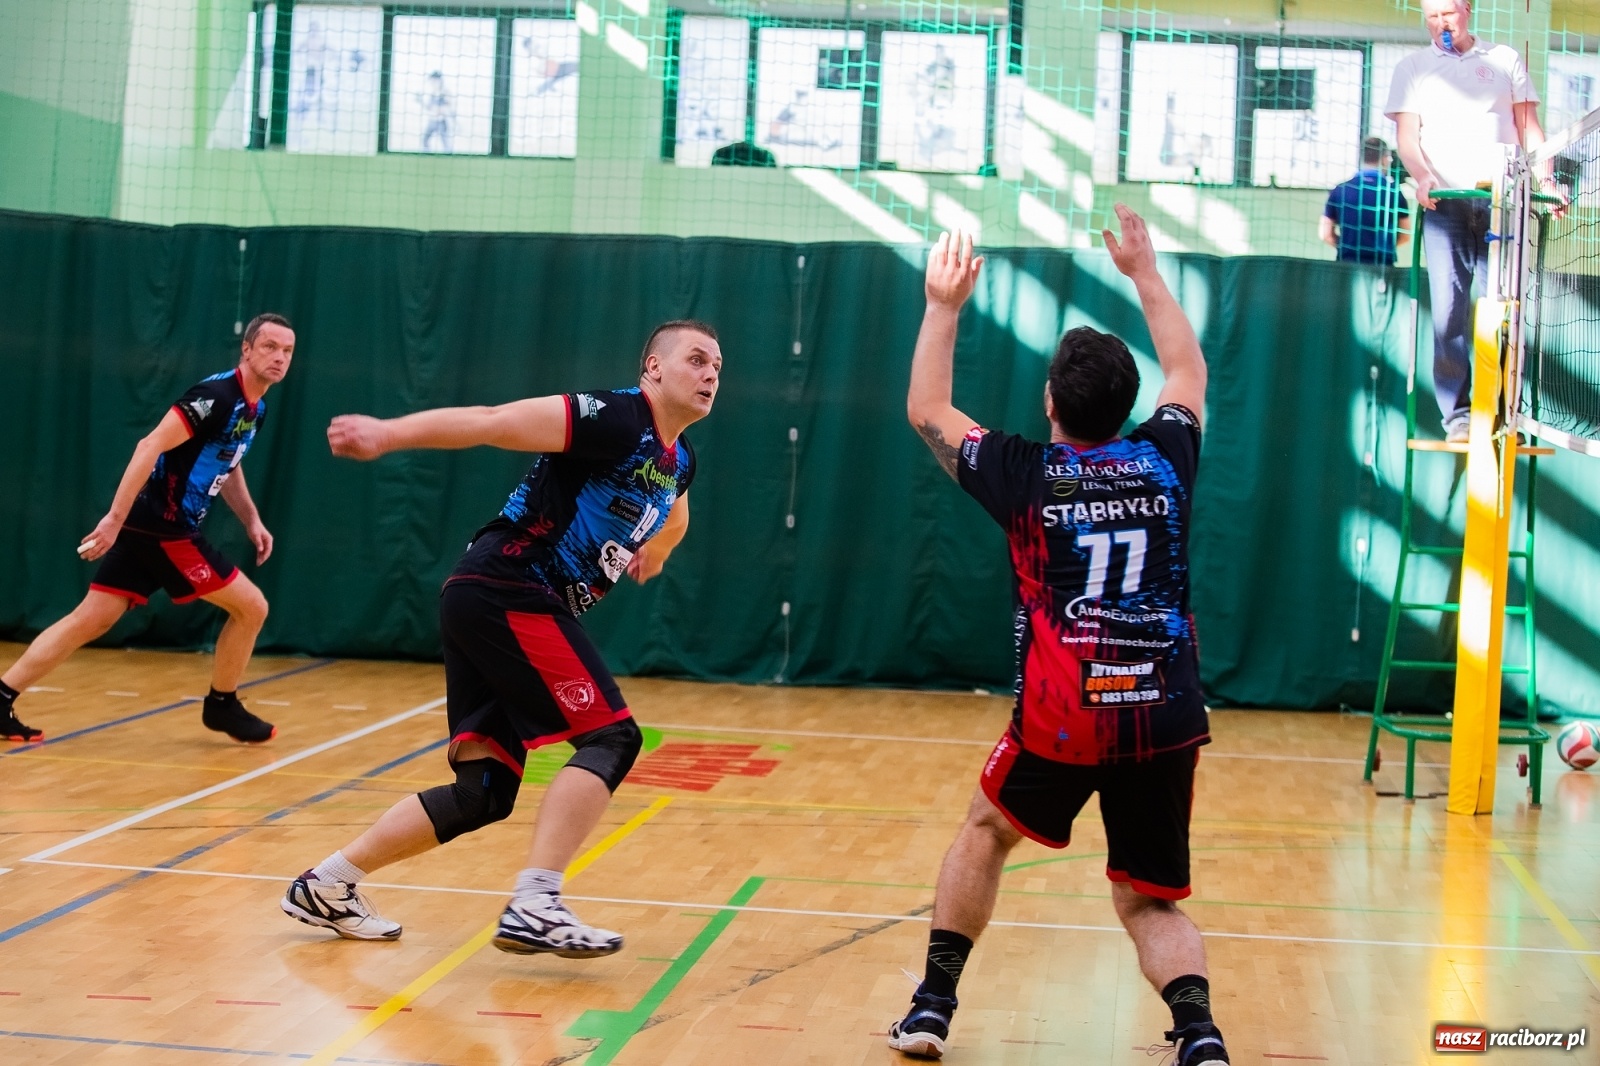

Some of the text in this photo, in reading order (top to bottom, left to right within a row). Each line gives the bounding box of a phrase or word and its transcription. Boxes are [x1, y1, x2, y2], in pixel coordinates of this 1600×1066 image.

[1042, 495, 1169, 527] STABRYŁO
[1077, 529, 1147, 597] 77
[1061, 635, 1100, 643] serwis
